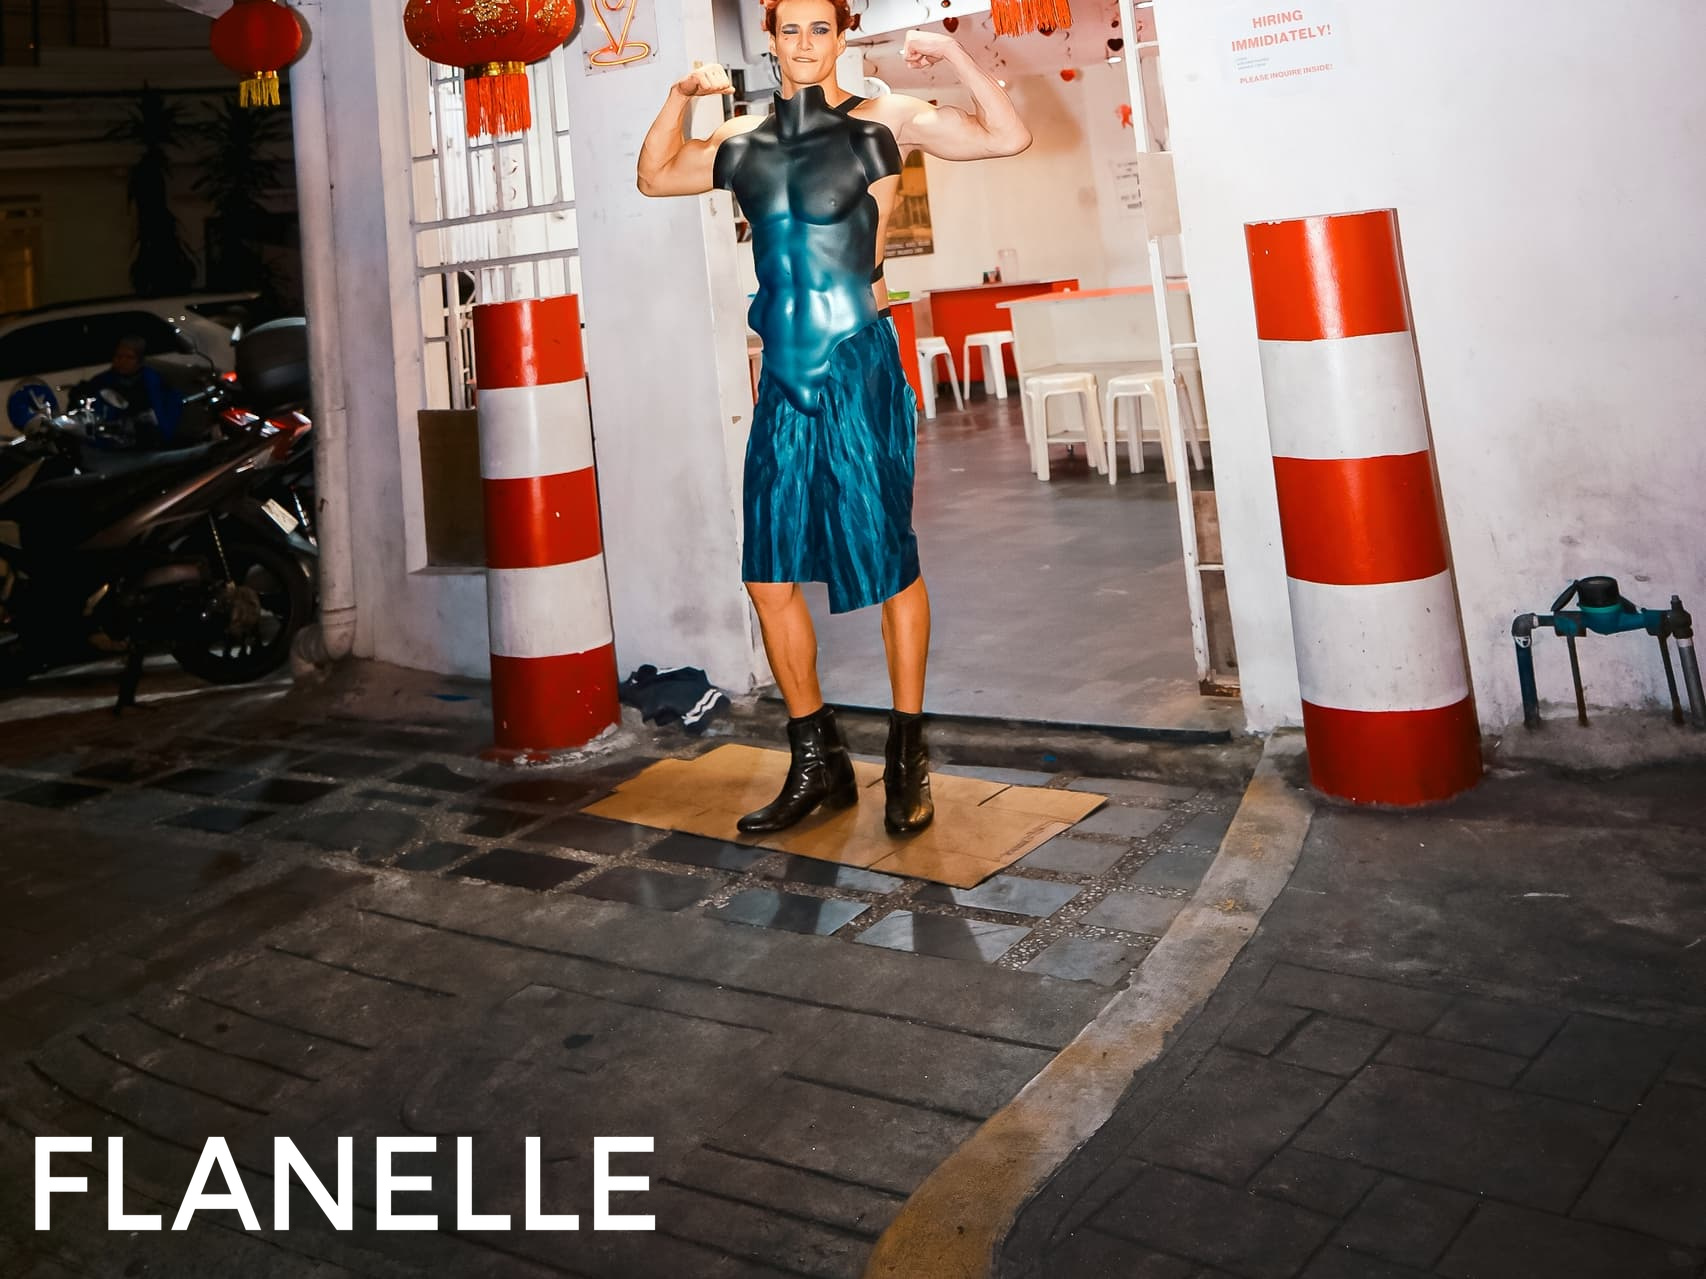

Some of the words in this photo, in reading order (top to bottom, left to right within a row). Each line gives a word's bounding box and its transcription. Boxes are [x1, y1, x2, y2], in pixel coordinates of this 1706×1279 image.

[1252, 9, 1304, 29] HIRING
[1231, 23, 1332, 52] IMMIDIATELY!
[1239, 73, 1270, 84] PLEASE
[1270, 68, 1303, 80] INQUIRE
